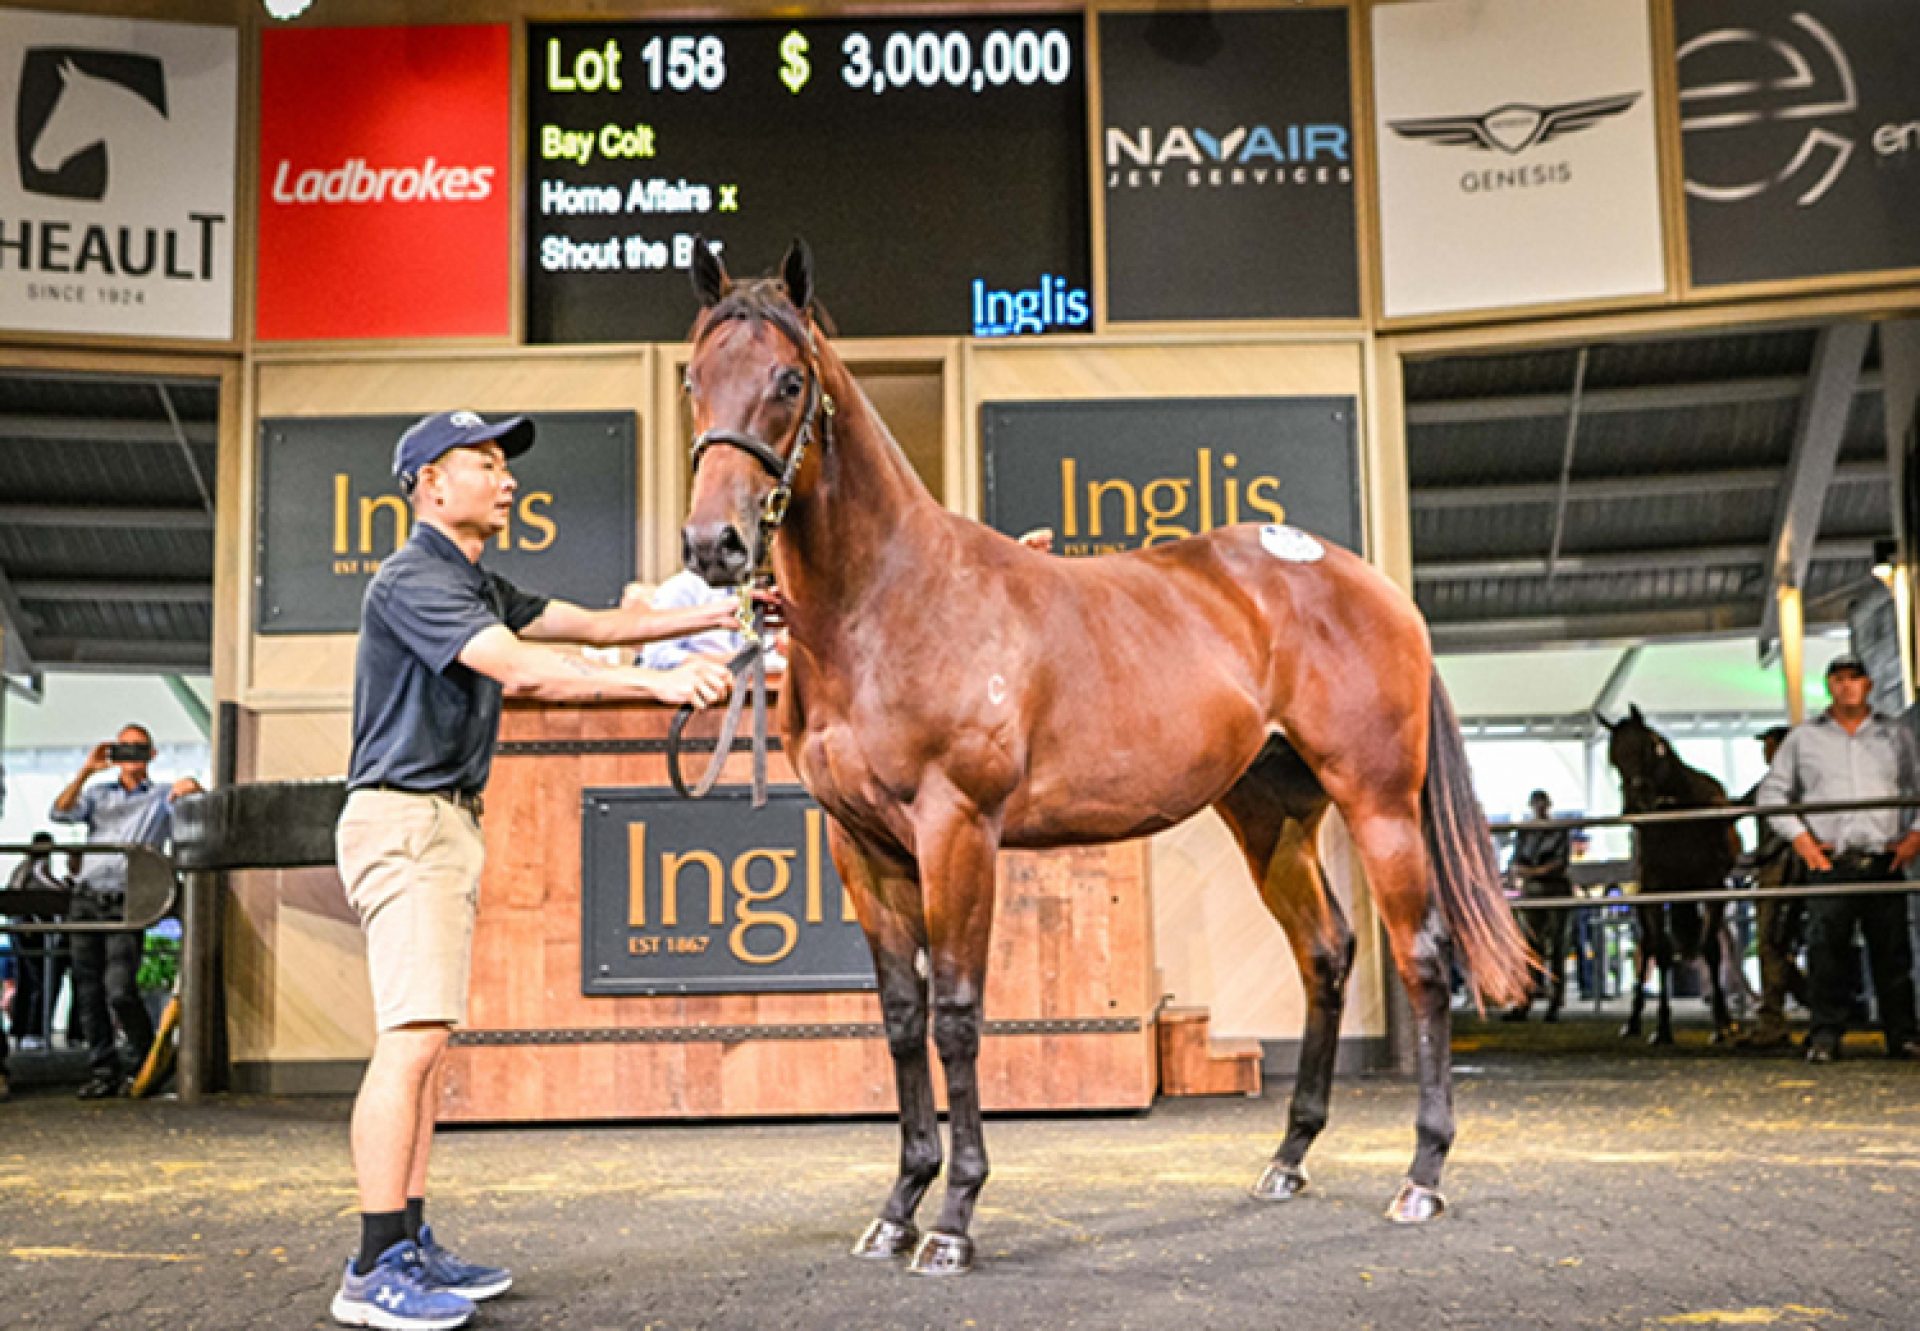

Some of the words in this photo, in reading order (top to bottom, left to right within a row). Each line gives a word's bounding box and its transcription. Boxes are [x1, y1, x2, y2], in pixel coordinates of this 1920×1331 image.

[547, 38, 622, 91] Lot
[641, 34, 726, 91] 158
[778, 29, 811, 94] $
[842, 29, 1071, 95] 3,000,000
[541, 124, 595, 166] Bay
[599, 123, 656, 159] Colt
[1106, 125, 1349, 165] NAVAIR
[272, 157, 494, 203] Ladbrokes
[541, 179, 622, 215] Home
[625, 179, 712, 213] Affairs
[718, 184, 739, 212] x
[1107, 170, 1162, 188] JET
[1187, 166, 1352, 188] SERVICES
[1460, 161, 1571, 193] GENESIS
[0, 213, 225, 281] HEAULT
[541, 233, 621, 271] Shout
[624, 234, 668, 269] the
[673, 233, 725, 270] Br
[28, 283, 83, 303] SINCE
[98, 287, 144, 305] 1924
[973, 273, 1089, 335] Inglis
[333, 472, 557, 555] Ins
[1061, 447, 1286, 549] Inglis
[627, 808, 858, 965] Ingl
[628, 936, 661, 955] EST
